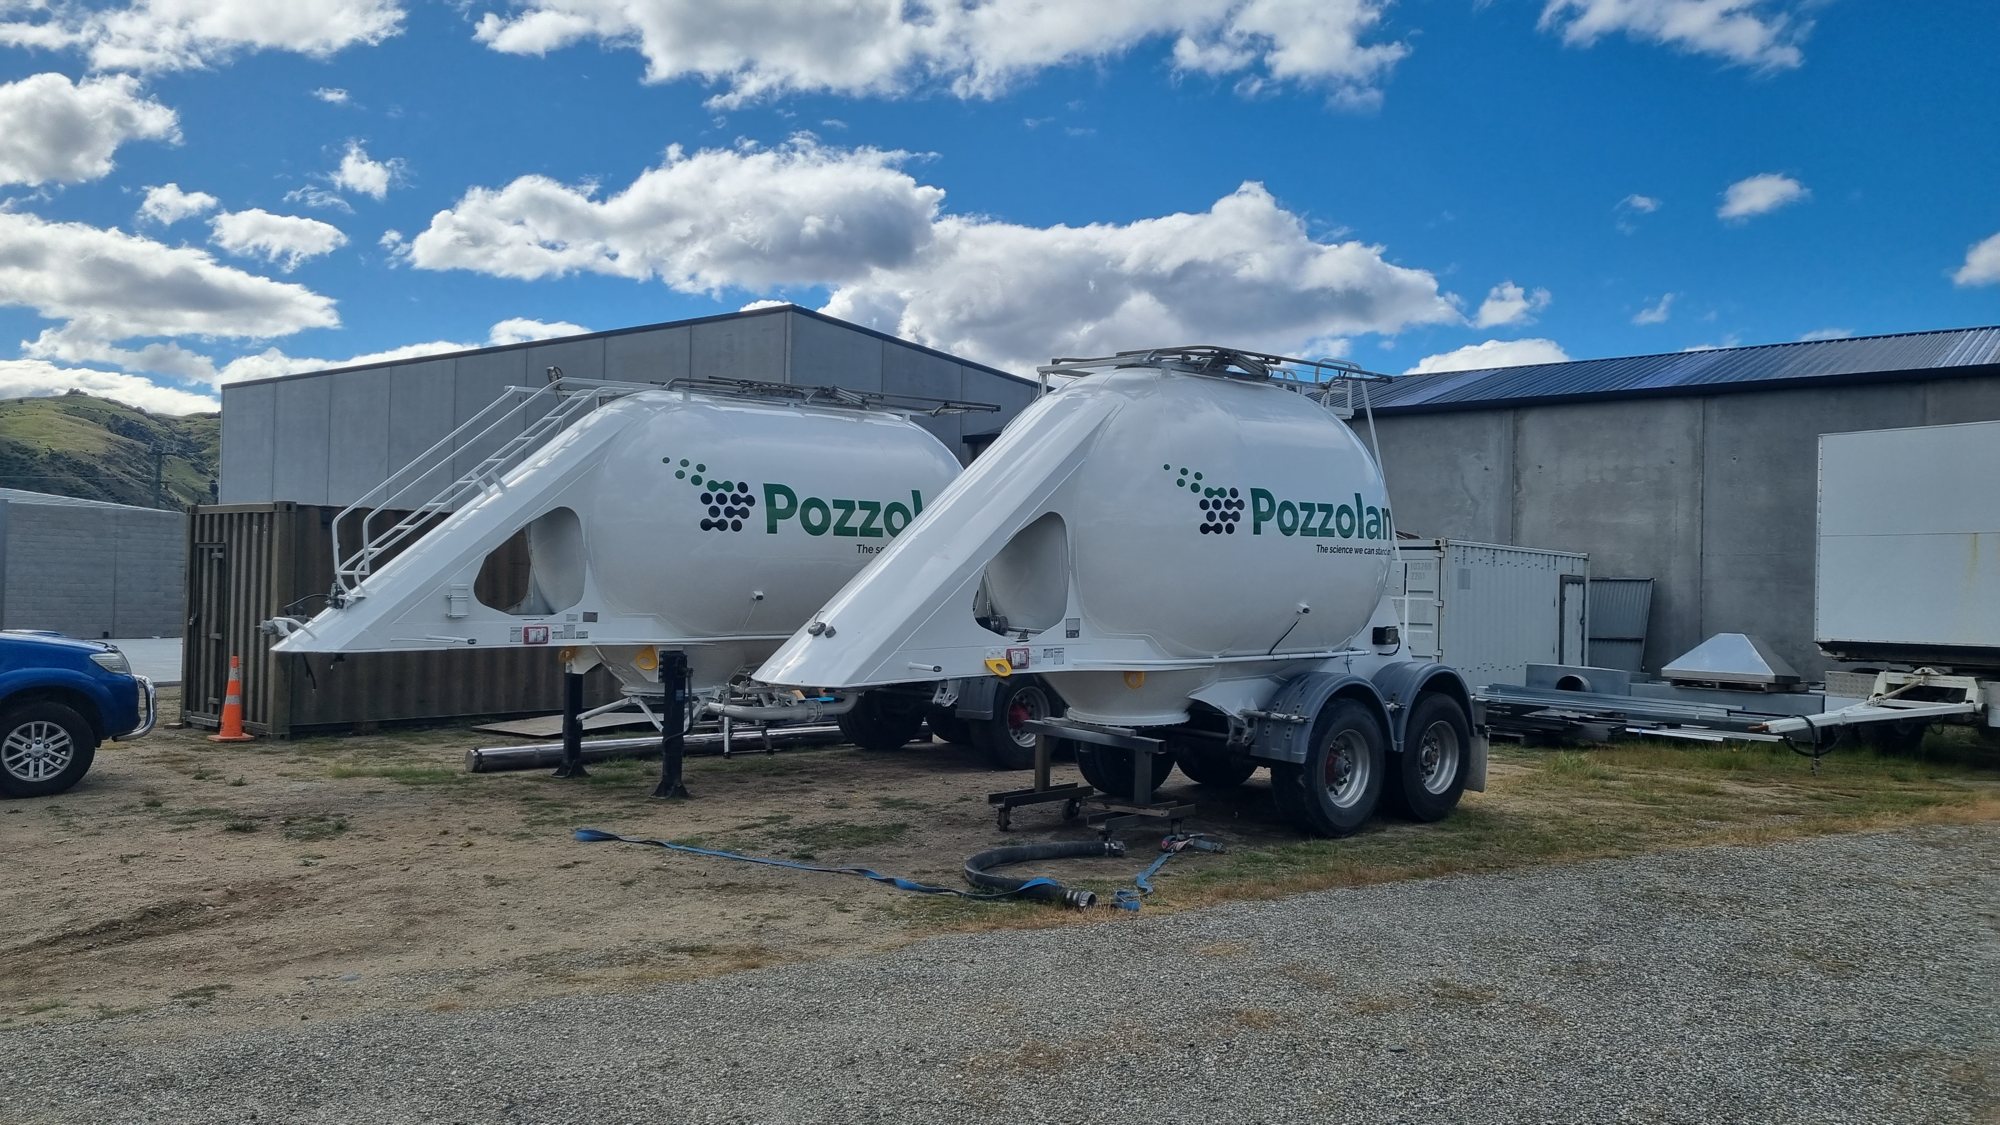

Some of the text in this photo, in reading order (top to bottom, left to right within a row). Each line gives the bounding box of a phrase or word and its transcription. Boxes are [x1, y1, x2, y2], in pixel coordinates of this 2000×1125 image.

[763, 483, 923, 538] Pozzol
[1250, 488, 1392, 541] Pozzolan
[856, 544, 873, 554] The
[1316, 544, 1328, 553] The
[1329, 545, 1353, 554] science
